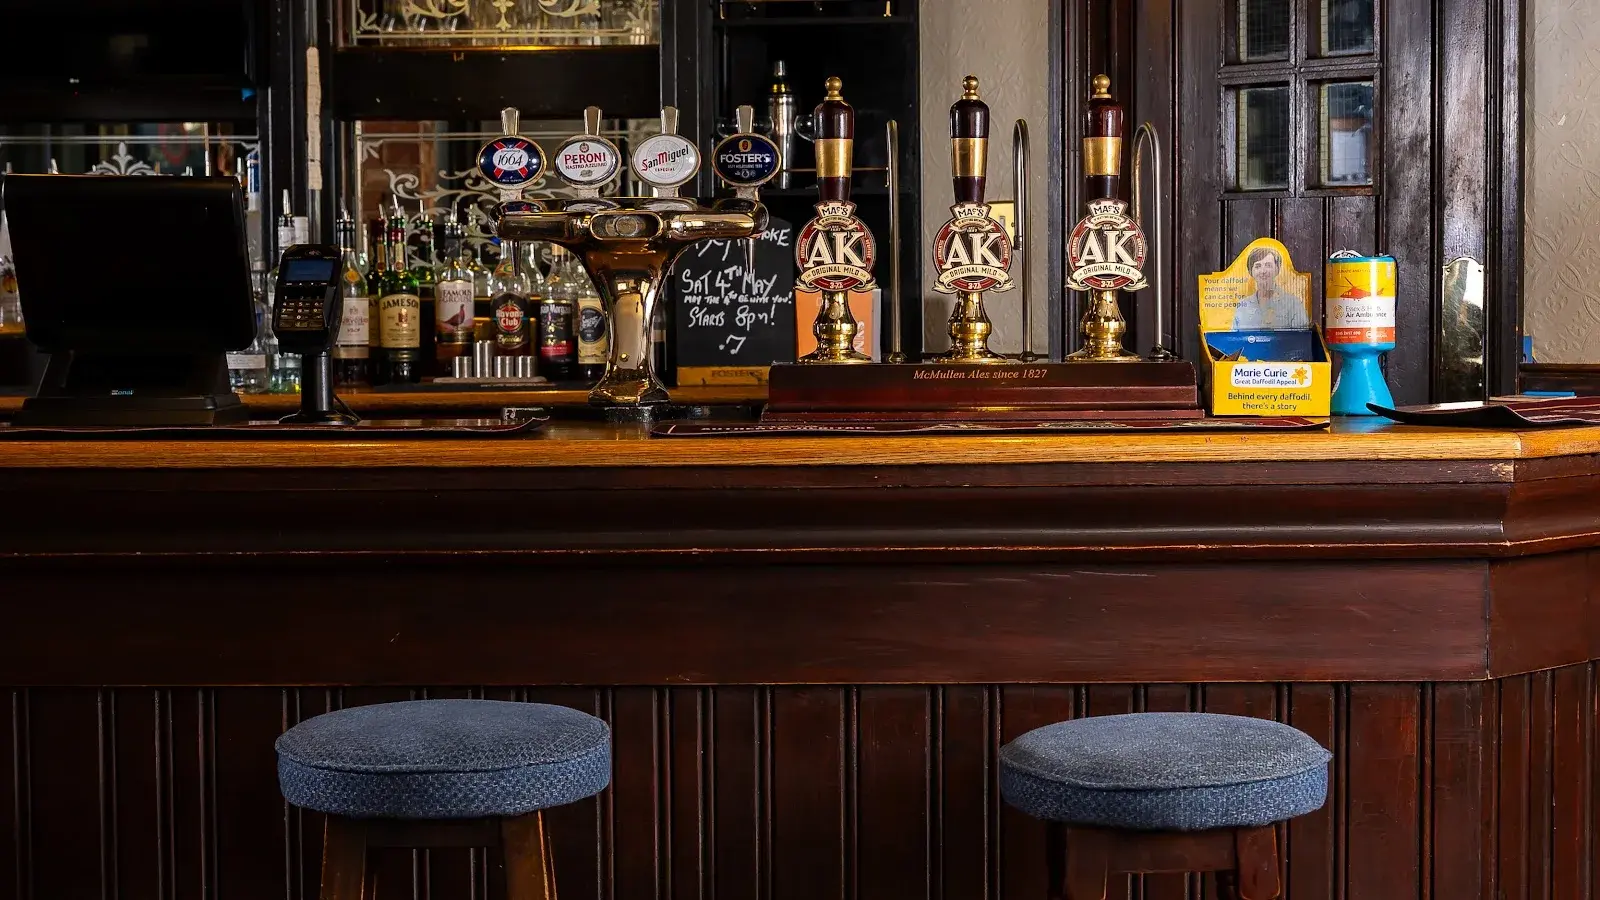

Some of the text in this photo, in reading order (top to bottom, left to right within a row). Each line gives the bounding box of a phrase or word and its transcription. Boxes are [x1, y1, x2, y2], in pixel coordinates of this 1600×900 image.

[498, 153, 523, 166] 1664
[564, 152, 606, 165] PERONI
[720, 153, 772, 163] FOSTER'S
[804, 231, 866, 267] AK
[942, 232, 1004, 269] AK
[1075, 230, 1137, 267] AK
[811, 265, 860, 277] ORIGINAL MILD
[949, 266, 998, 277] ORIGINAL MILD
[1083, 264, 1131, 275] ORIGINAL MILD
[682, 269, 712, 295] SAT
[742, 269, 778, 298] MAY
[443, 289, 472, 297] FAMOUS
[683, 295, 702, 305] MAY
[704, 295, 720, 304] THE
[1223, 301, 1248, 309] people
[495, 309, 524, 318] Havana
[500, 317, 518, 326] Club
[913, 369, 1048, 380] McMullen Ales since 1827
[1234, 368, 1288, 377] Marie Curie
[1227, 392, 1255, 400] Behind
[1256, 394, 1278, 402] every
[1242, 402, 1269, 410] there's
[1276, 403, 1297, 411] story
